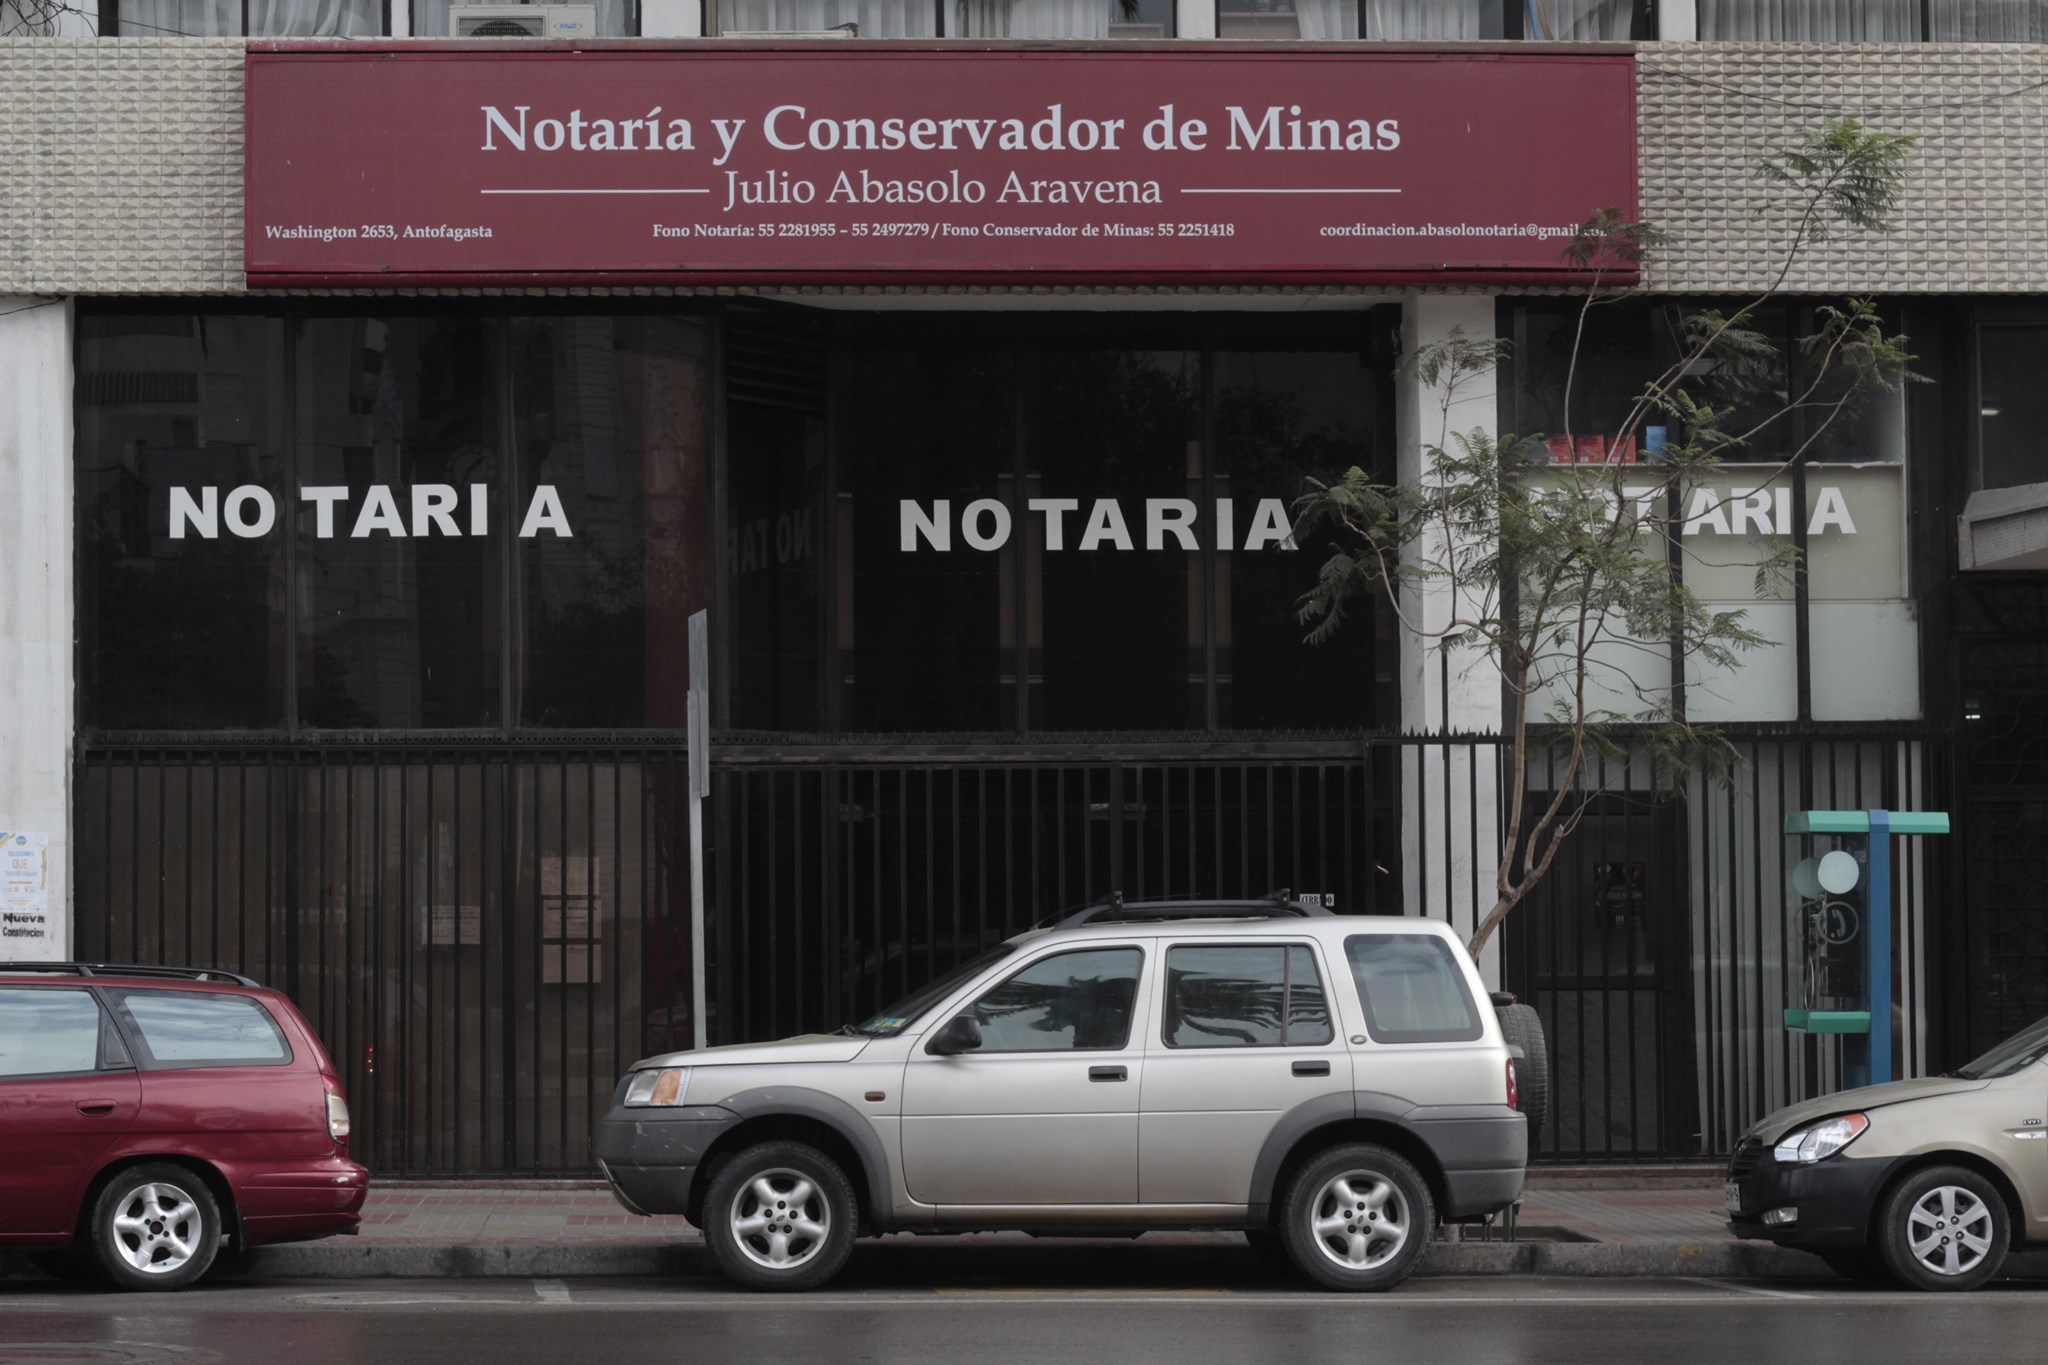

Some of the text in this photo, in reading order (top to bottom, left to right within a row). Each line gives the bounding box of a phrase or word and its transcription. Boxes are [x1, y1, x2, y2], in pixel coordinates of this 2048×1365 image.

[481, 104, 1401, 166] Notaría y Conservador de Minas
[724, 169, 1163, 210] Julio Abasolo Aravena
[265, 224, 493, 242] Washington 2653, Antofagasta
[653, 223, 691, 238] Fono
[694, 223, 755, 237] Notaría:
[758, 223, 775, 237] 55
[778, 223, 836, 237] 2281955
[852, 223, 869, 237] 55
[943, 222, 980, 237] Fono
[983, 222, 1078, 237] Conservador
[1081, 222, 1100, 237] de
[1103, 223, 1155, 237] Minas:
[1158, 223, 1175, 237] 55
[1178, 223, 1235, 237] 2251418
[12, 858, 29, 869] QUE
[1302, 896, 1332, 905] CERRO
[3, 912, 45, 923] Nueva
